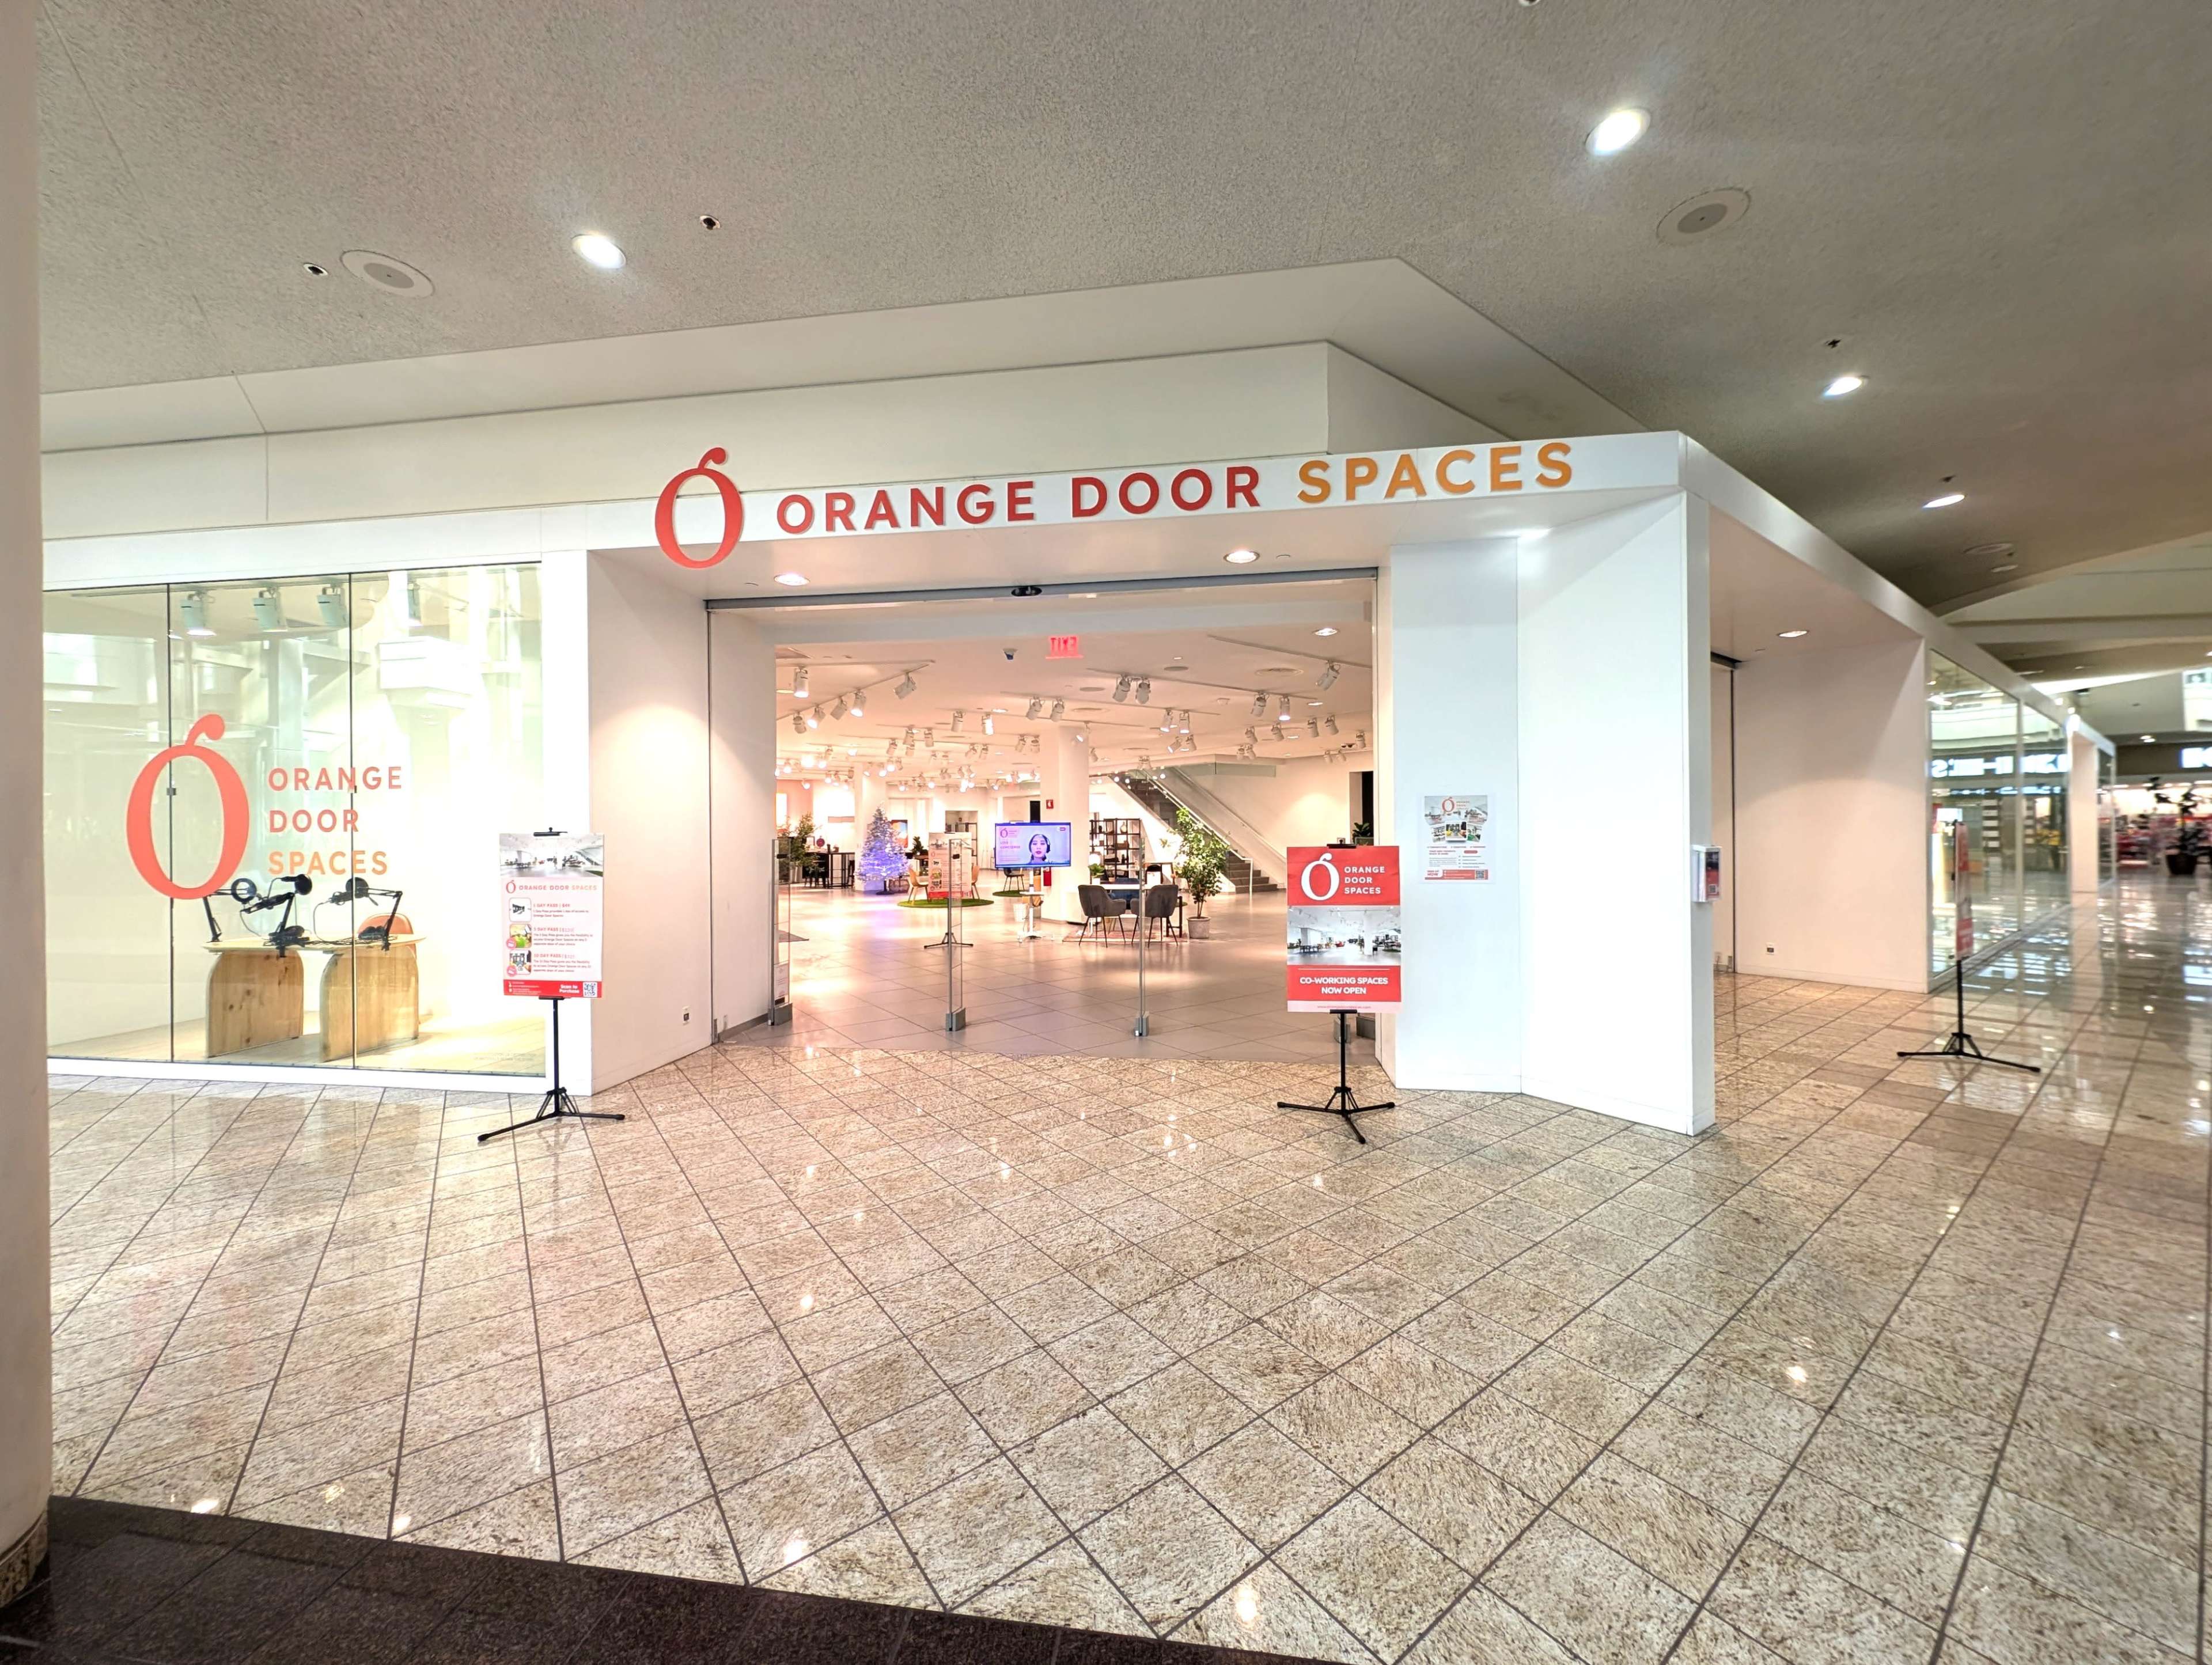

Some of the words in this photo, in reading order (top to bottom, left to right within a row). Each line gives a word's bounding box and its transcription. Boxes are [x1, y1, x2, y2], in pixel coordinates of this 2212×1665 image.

[777, 480, 1035, 534] ORANGE
[1071, 466, 1260, 518] DOOR
[1297, 442, 1573, 504] SPACES
[268, 767, 402, 791] ORANGE
[270, 809, 358, 833] DOOR
[268, 851, 388, 875] SPACES
